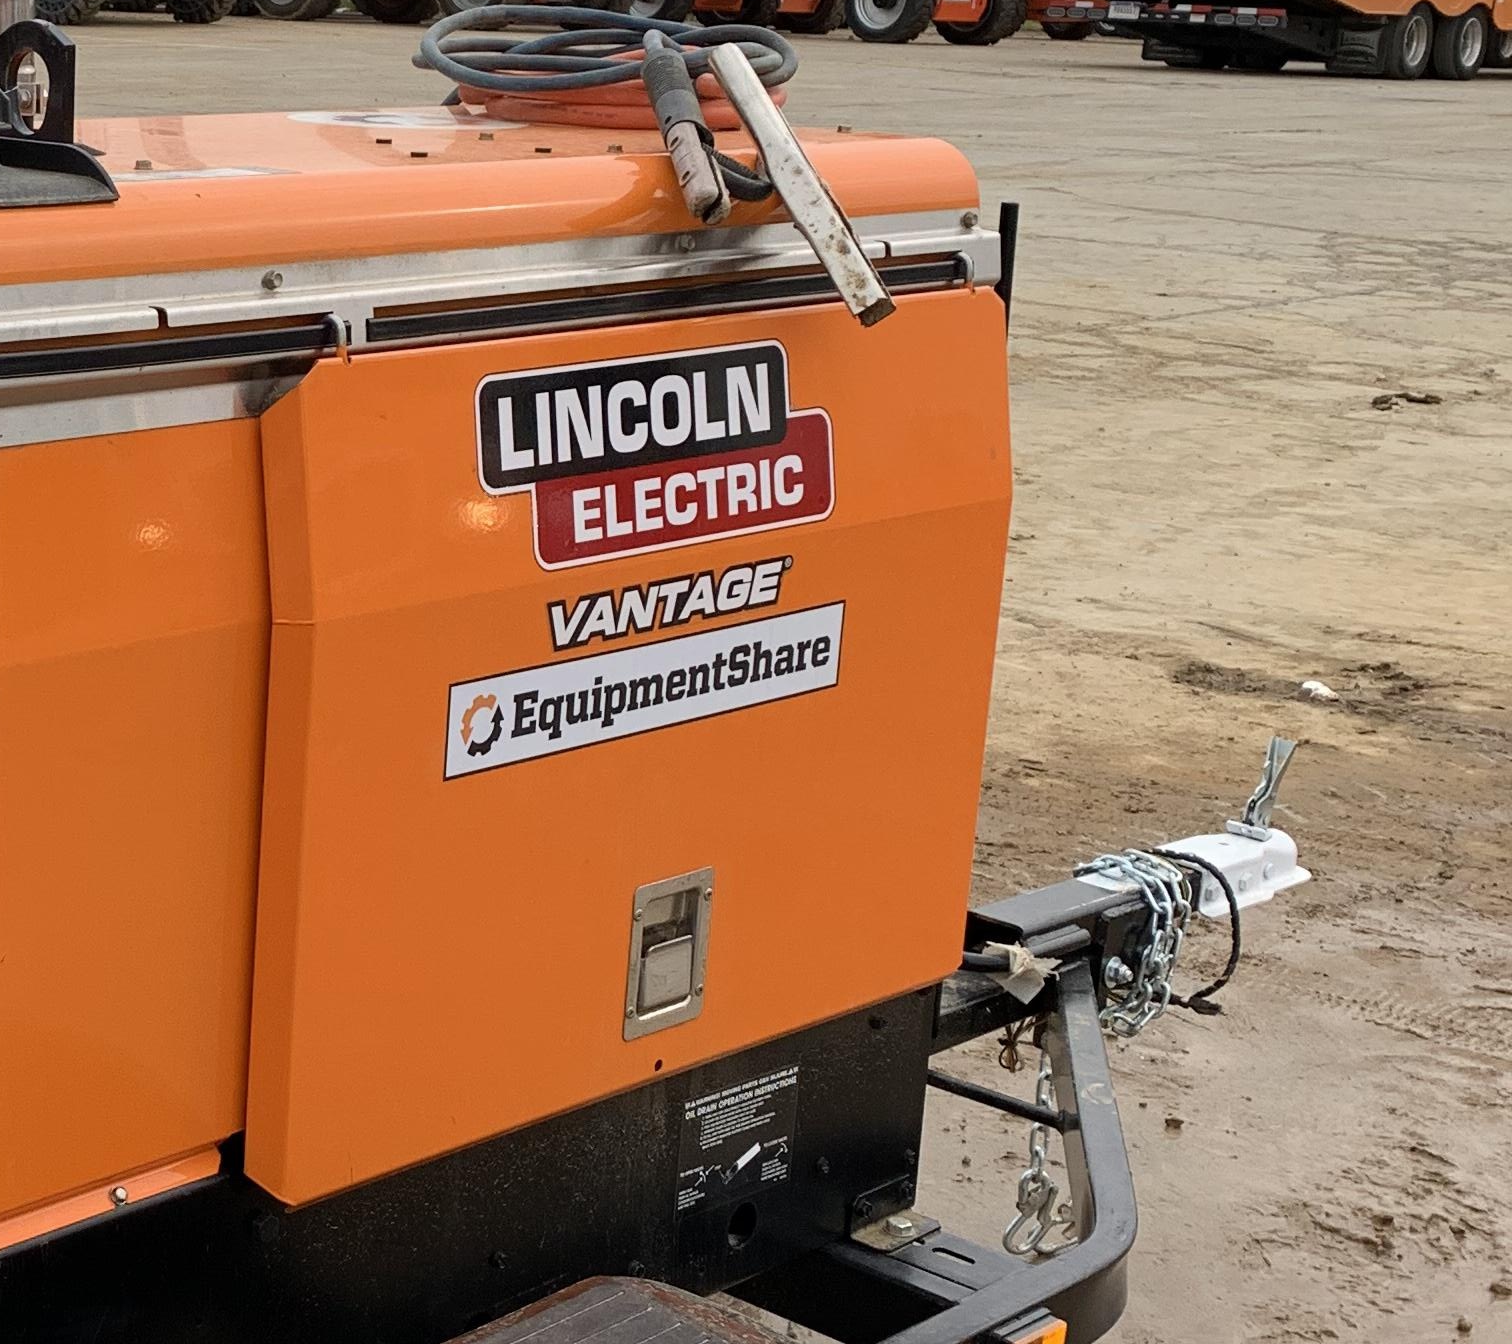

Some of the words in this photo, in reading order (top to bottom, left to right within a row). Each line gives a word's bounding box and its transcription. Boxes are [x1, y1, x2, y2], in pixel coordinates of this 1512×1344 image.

[498, 363, 772, 471] LINCOLN
[572, 455, 804, 544] ELECTRIC
[511, 633, 830, 740] EquipmentShare
